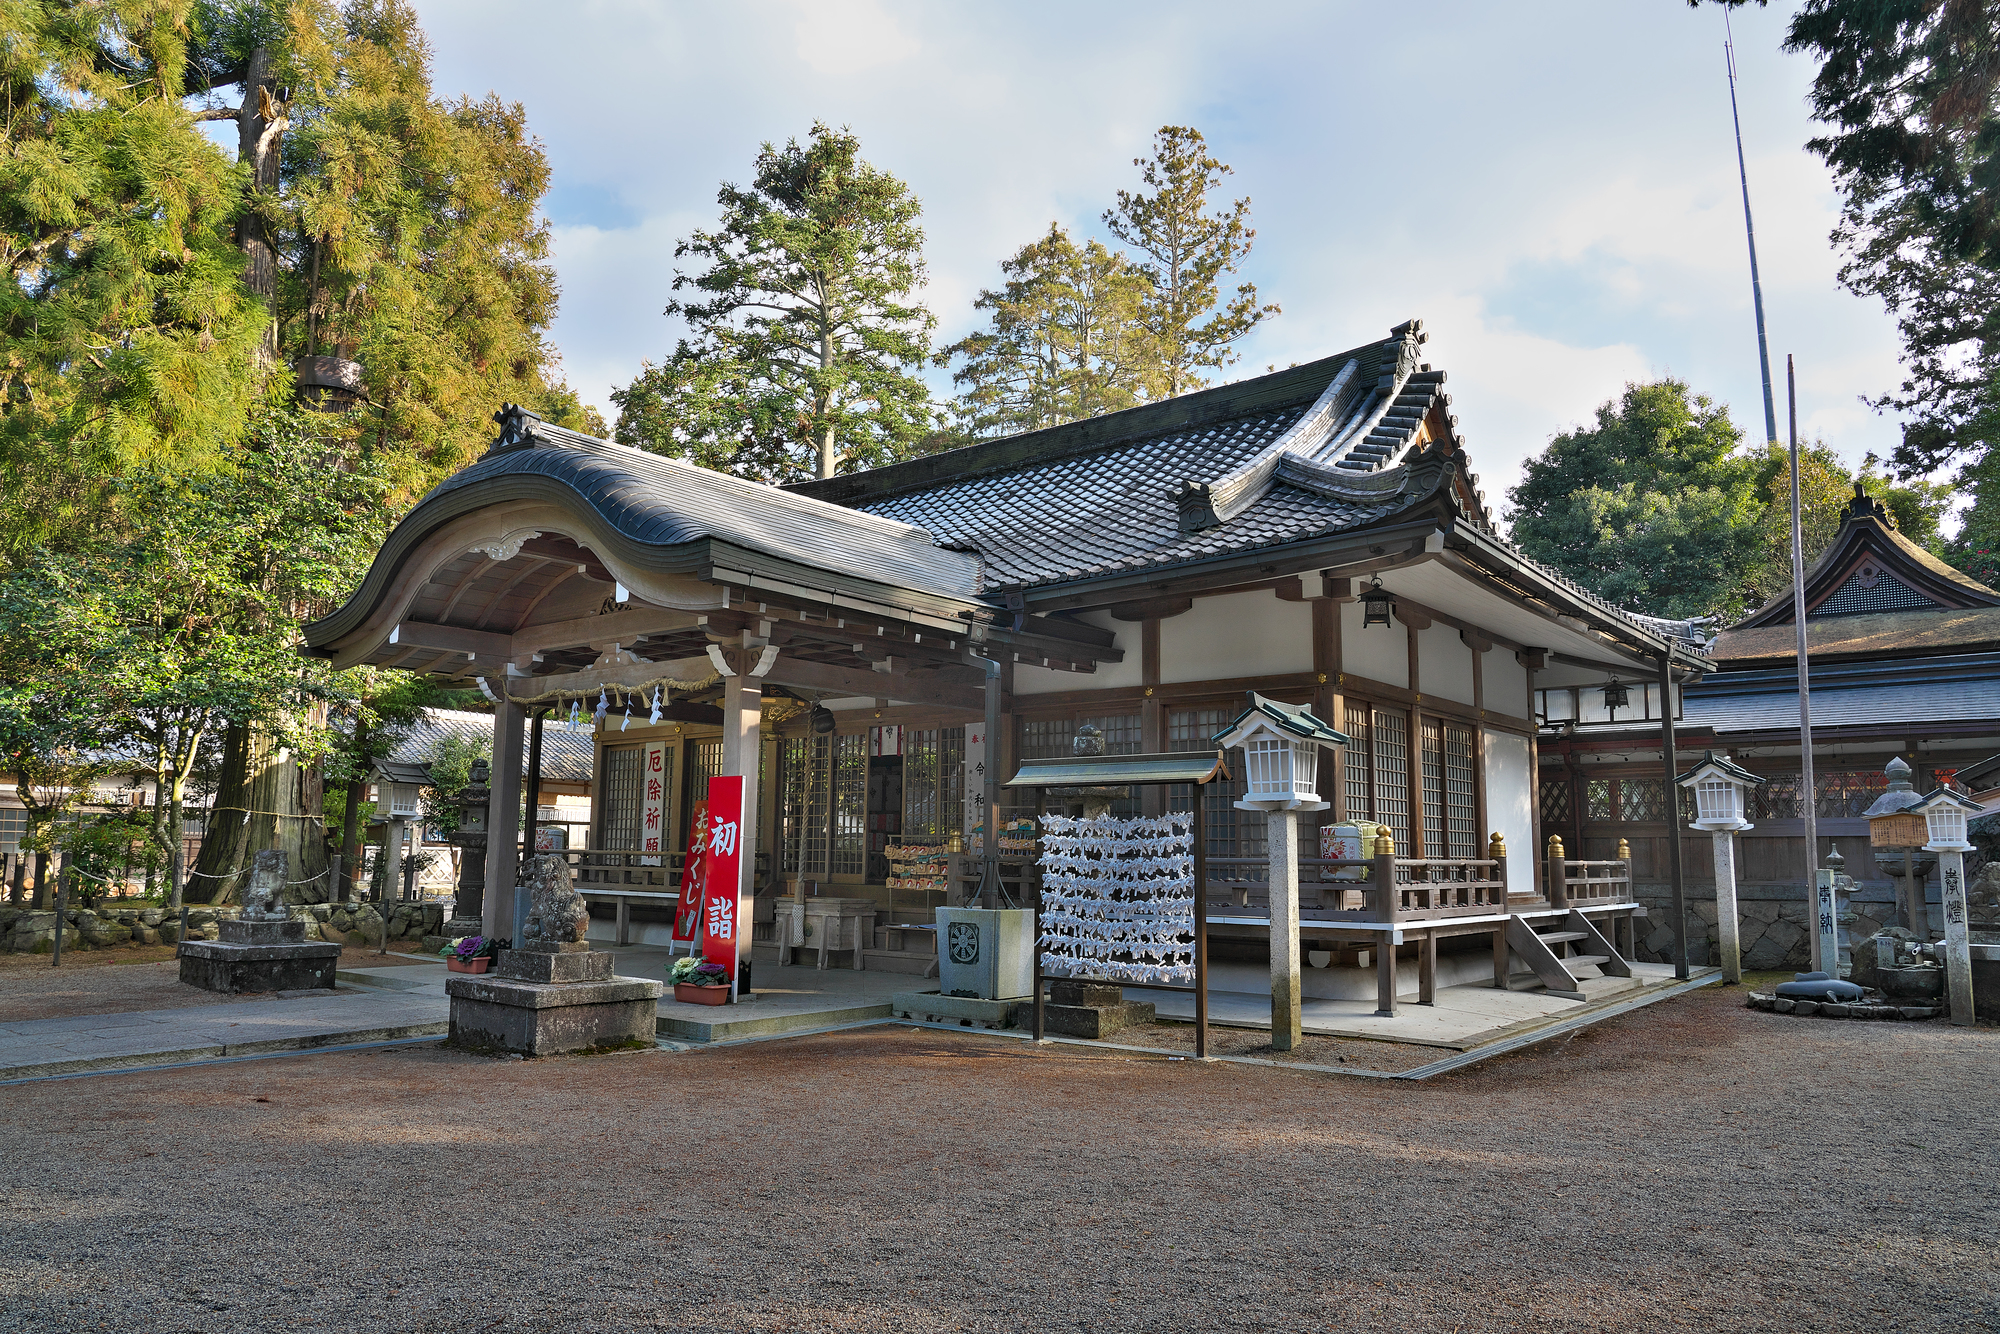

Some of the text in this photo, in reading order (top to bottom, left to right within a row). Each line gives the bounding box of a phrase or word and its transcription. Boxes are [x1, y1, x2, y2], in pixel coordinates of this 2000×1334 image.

[645, 749, 662, 859] 厄除祈願
[975, 762, 985, 806] 令和
[685, 808, 708, 905] おみくじ
[708, 815, 738, 940] 初詣
[1818, 884, 1834, 935] 奉納
